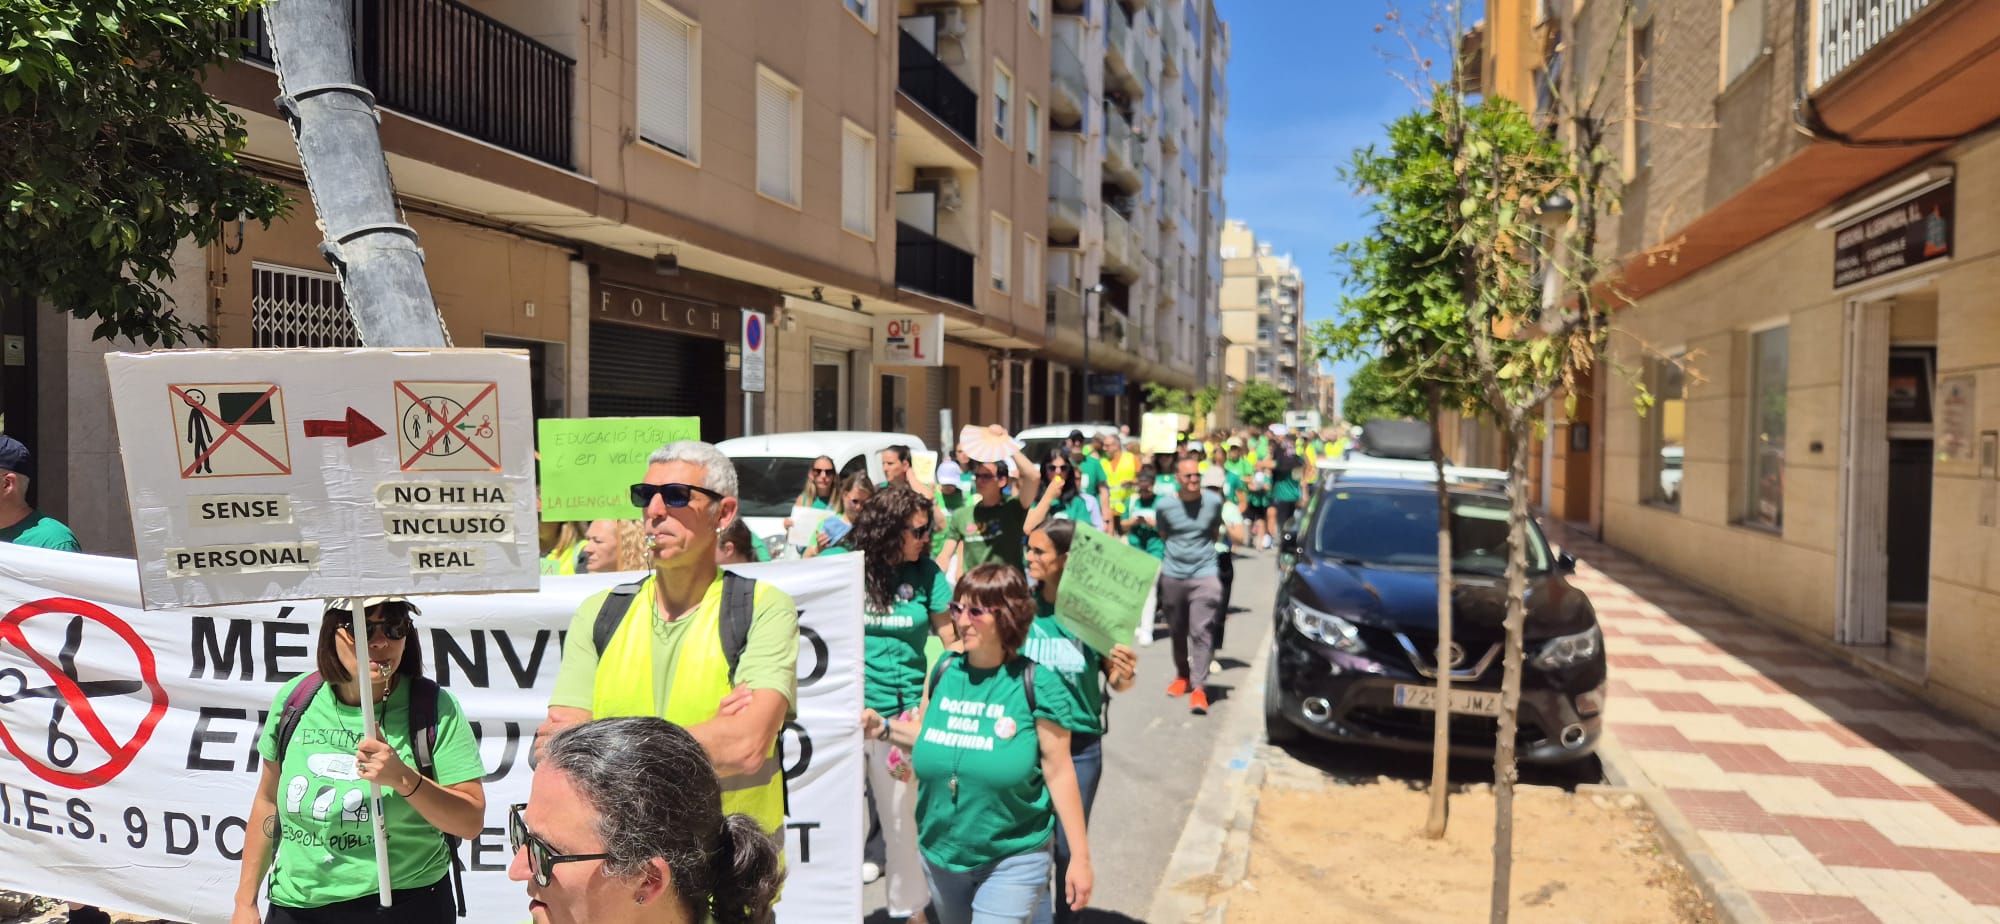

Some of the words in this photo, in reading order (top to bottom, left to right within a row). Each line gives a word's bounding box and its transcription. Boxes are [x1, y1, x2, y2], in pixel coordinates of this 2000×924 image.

[601, 291, 720, 331] FOLCH
[554, 426, 628, 446] EDUCACIÓ
[633, 426, 692, 443] PÚBLICA
[574, 451, 597, 466] en
[394, 486, 431, 504] NO
[439, 486, 465, 503] HI
[473, 486, 506, 504] HA
[548, 497, 562, 510] LA
[202, 500, 279, 520] SENSE
[392, 515, 506, 535] INCLUSIÓ
[177, 547, 310, 570] PERSONAL
[418, 551, 475, 568] REAL
[189, 607, 310, 683] MÉ
[940, 696, 986, 717] DOCENT
[986, 703, 1005, 719] EN
[1463, 696, 1496, 712] JMZ
[947, 715, 980, 734] VAGA
[924, 727, 994, 752] INDEFINIDA
[0, 782, 108, 844] I.E.S.
[124, 806, 149, 849] 9
